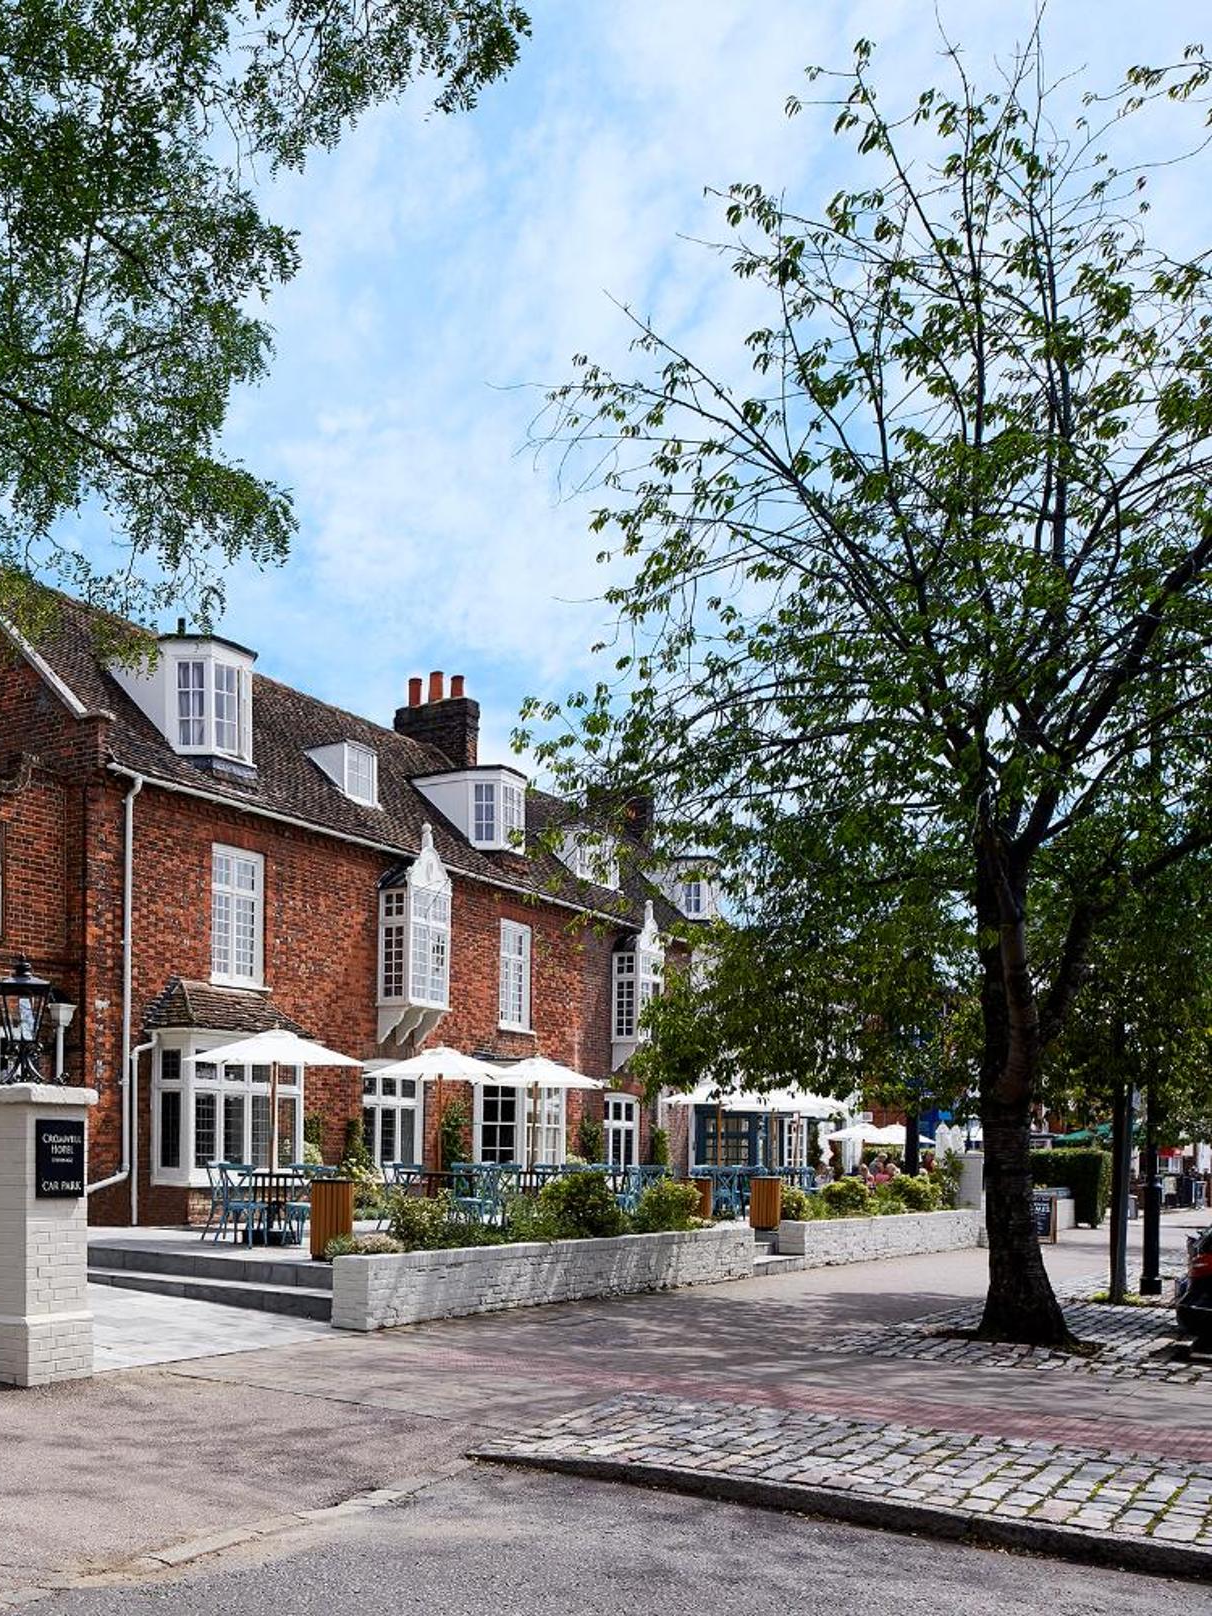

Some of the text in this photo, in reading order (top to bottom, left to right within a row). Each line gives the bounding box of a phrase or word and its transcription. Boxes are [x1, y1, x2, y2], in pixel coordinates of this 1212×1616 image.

[51, 1144, 74, 1154] HOTEL
[42, 1181, 82, 1191] CAR PARK
